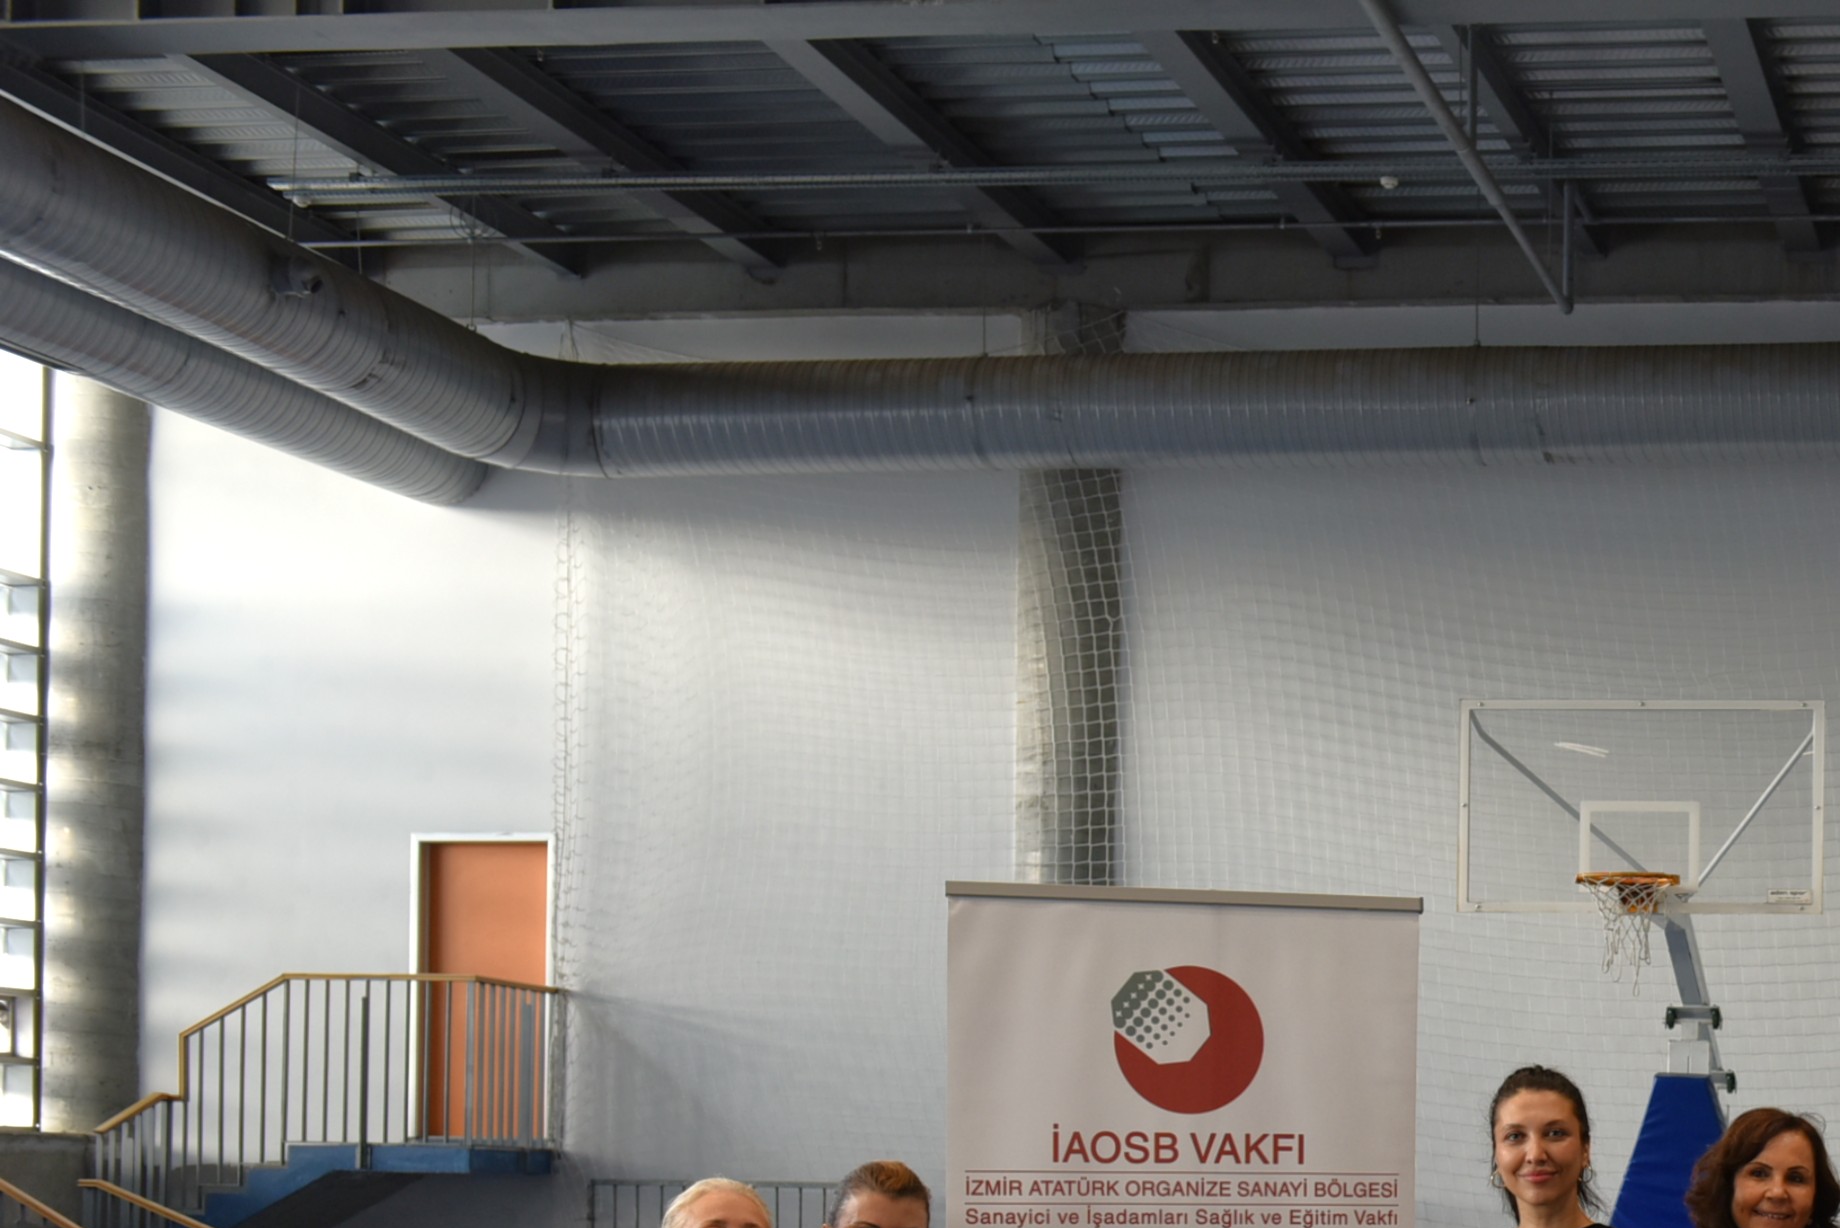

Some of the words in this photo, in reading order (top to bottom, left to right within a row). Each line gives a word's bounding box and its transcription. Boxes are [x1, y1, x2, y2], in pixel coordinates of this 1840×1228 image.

[1051, 1123, 1179, 1166] İAOSB
[1190, 1132, 1305, 1166] VAKFI
[965, 1175, 1023, 1198] İZMİR
[1028, 1176, 1120, 1198] ATATÜRK
[1125, 1177, 1232, 1199] ORGANİZE
[1237, 1177, 1309, 1199] SANAYİ
[1313, 1177, 1399, 1200] BÖLGESİ
[964, 1206, 1051, 1228] Sanayici
[1057, 1213, 1080, 1226] ve
[1086, 1205, 1188, 1228] İşadamları
[1195, 1208, 1254, 1228] Sağlık
[1259, 1213, 1282, 1226] ve
[1353, 1208, 1399, 1226] Vakfı
